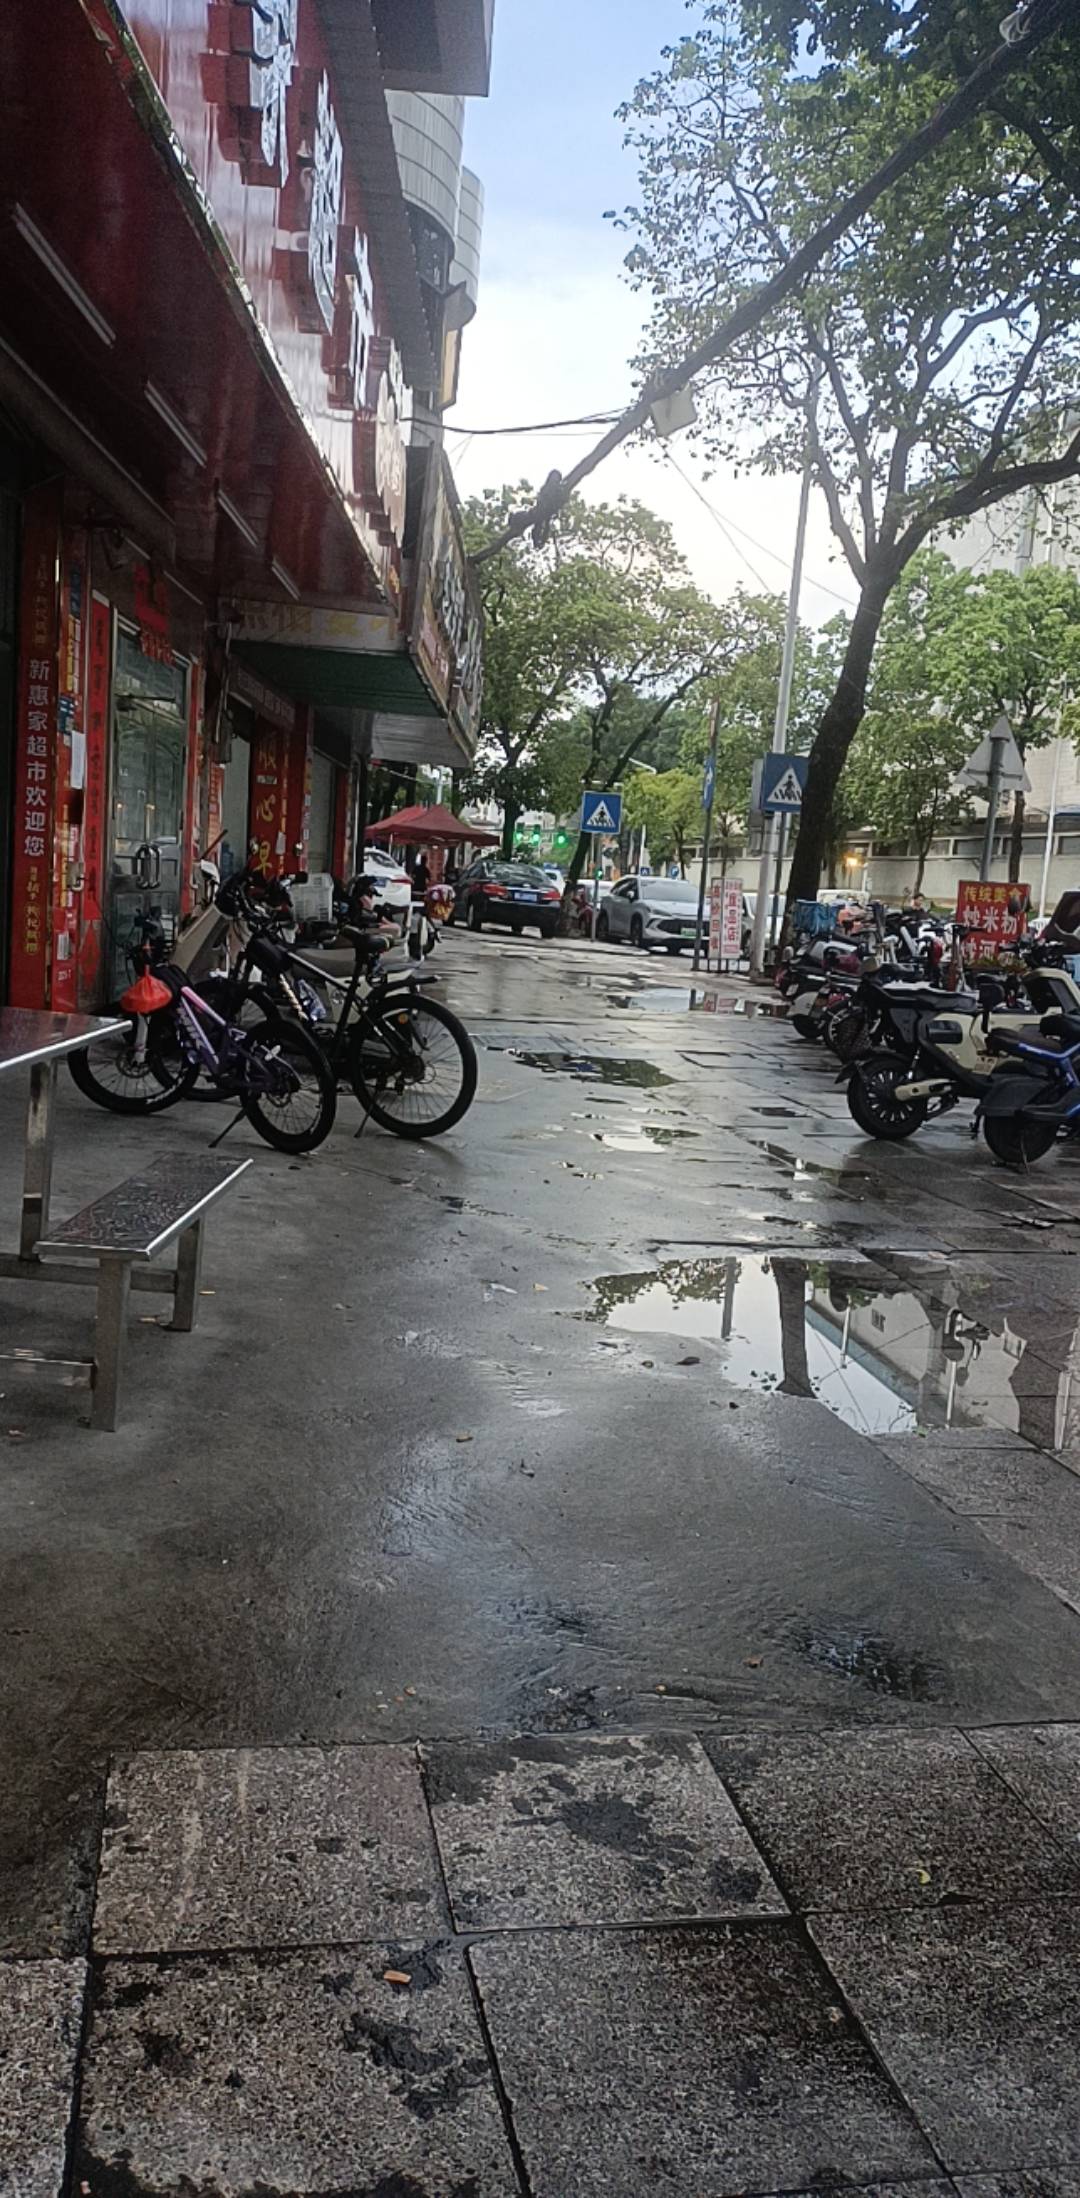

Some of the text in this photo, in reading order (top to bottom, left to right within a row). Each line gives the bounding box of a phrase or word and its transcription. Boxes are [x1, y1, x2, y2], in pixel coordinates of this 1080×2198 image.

[24, 659, 50, 858] 新惠家超市欢迎您
[962, 905, 1018, 935] 炒米粉
